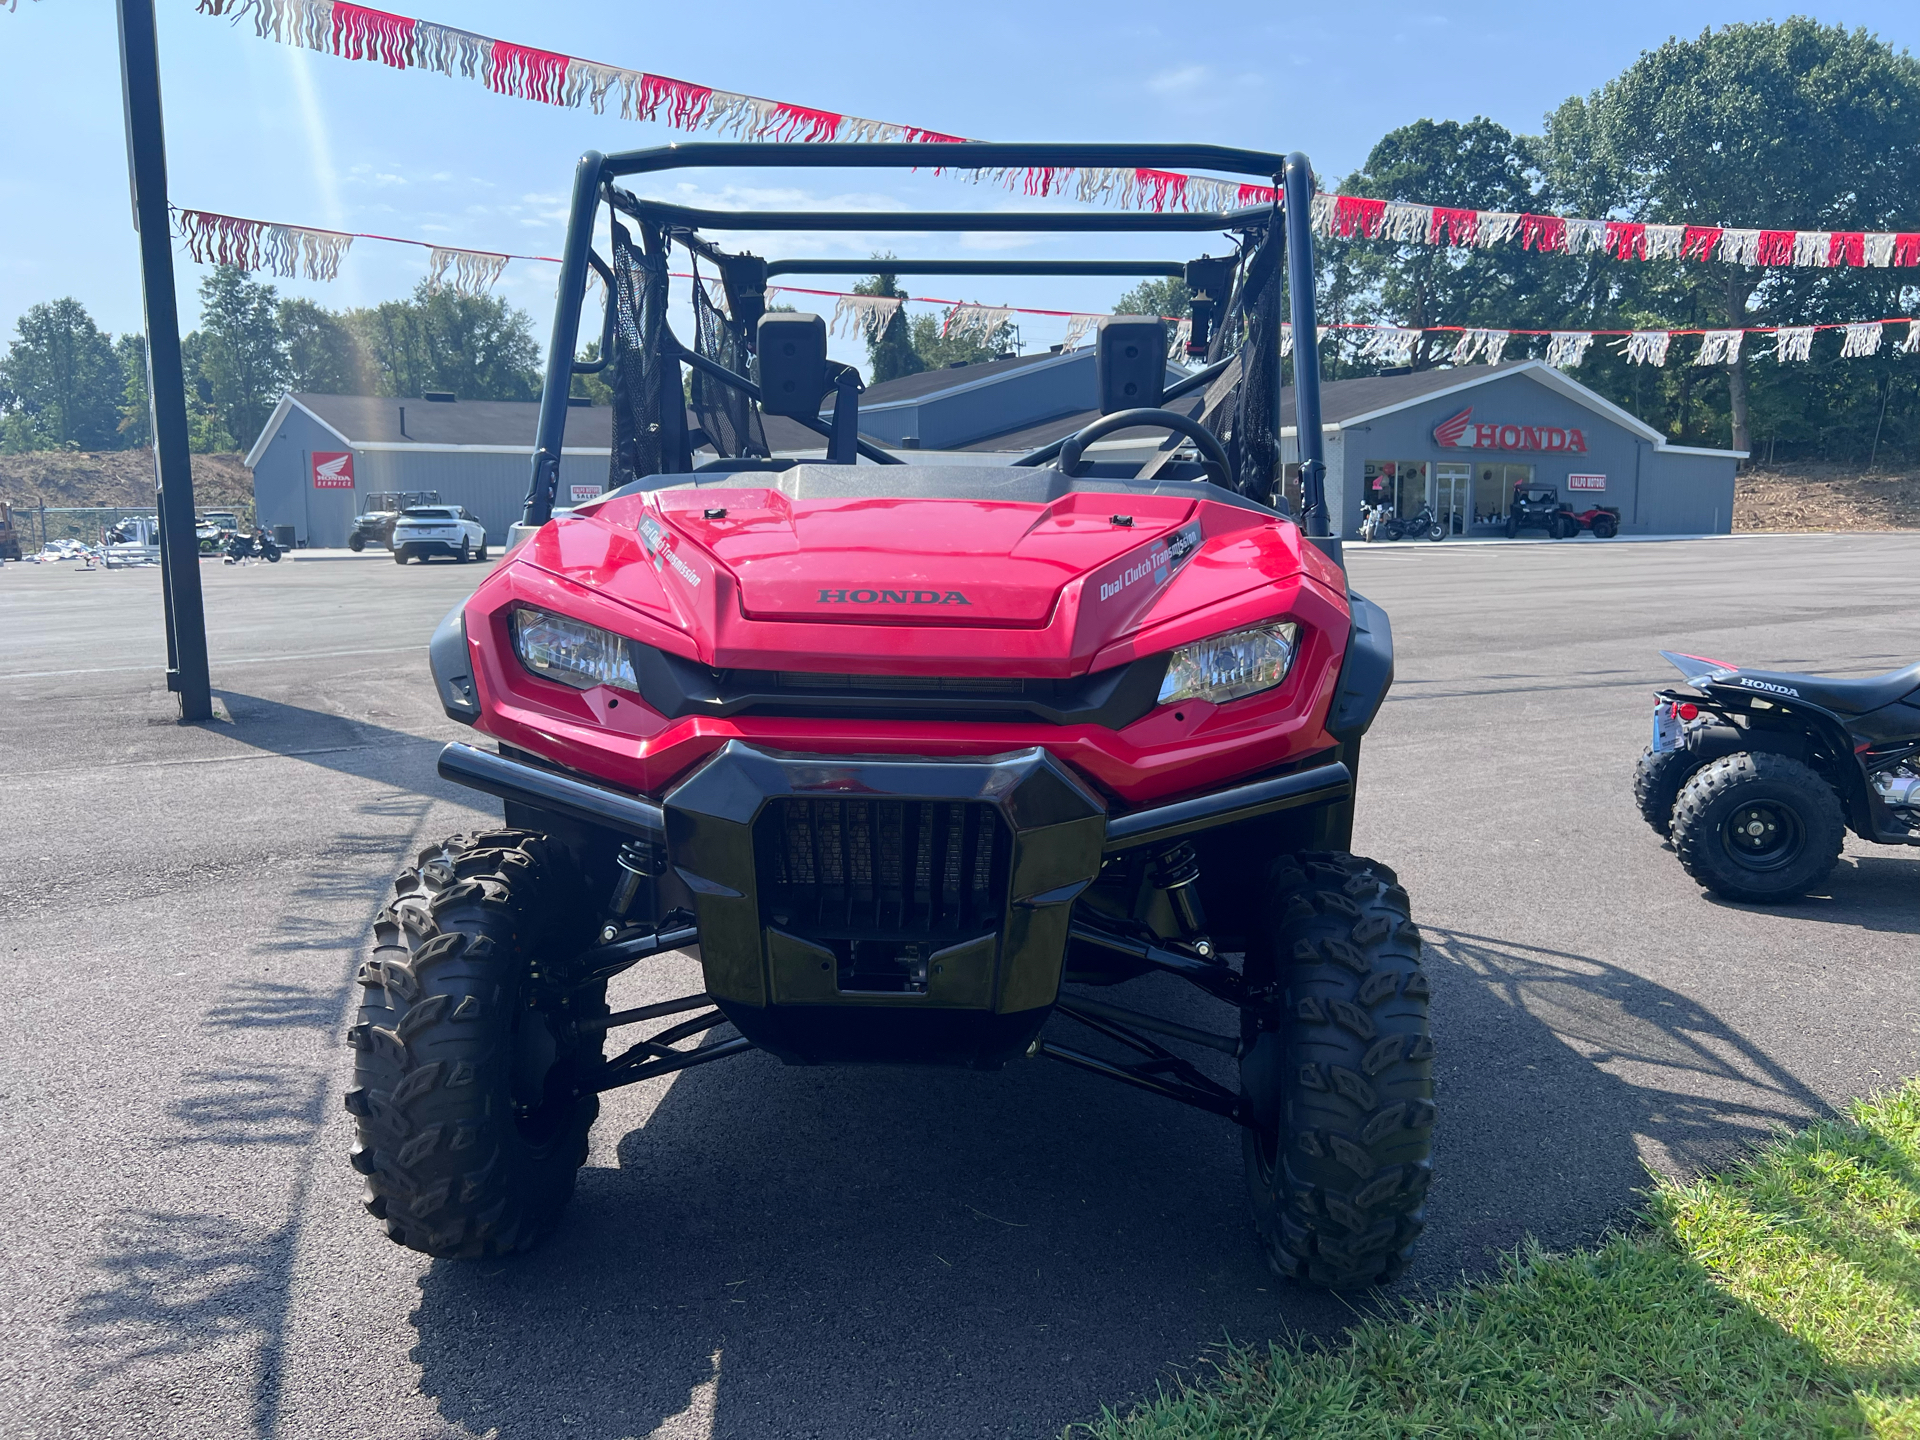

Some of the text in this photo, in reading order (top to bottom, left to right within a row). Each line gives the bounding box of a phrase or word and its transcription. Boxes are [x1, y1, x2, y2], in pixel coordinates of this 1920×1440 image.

[1473, 424, 1588, 452] HONDA
[1571, 477, 1605, 488] VALPO MOTORS
[640, 520, 701, 587] Dual Clutch Transmission
[1100, 531, 1197, 602] Dual Clutch Transmission
[816, 589, 972, 605] HONDA
[1740, 678, 1800, 698] HONDA
